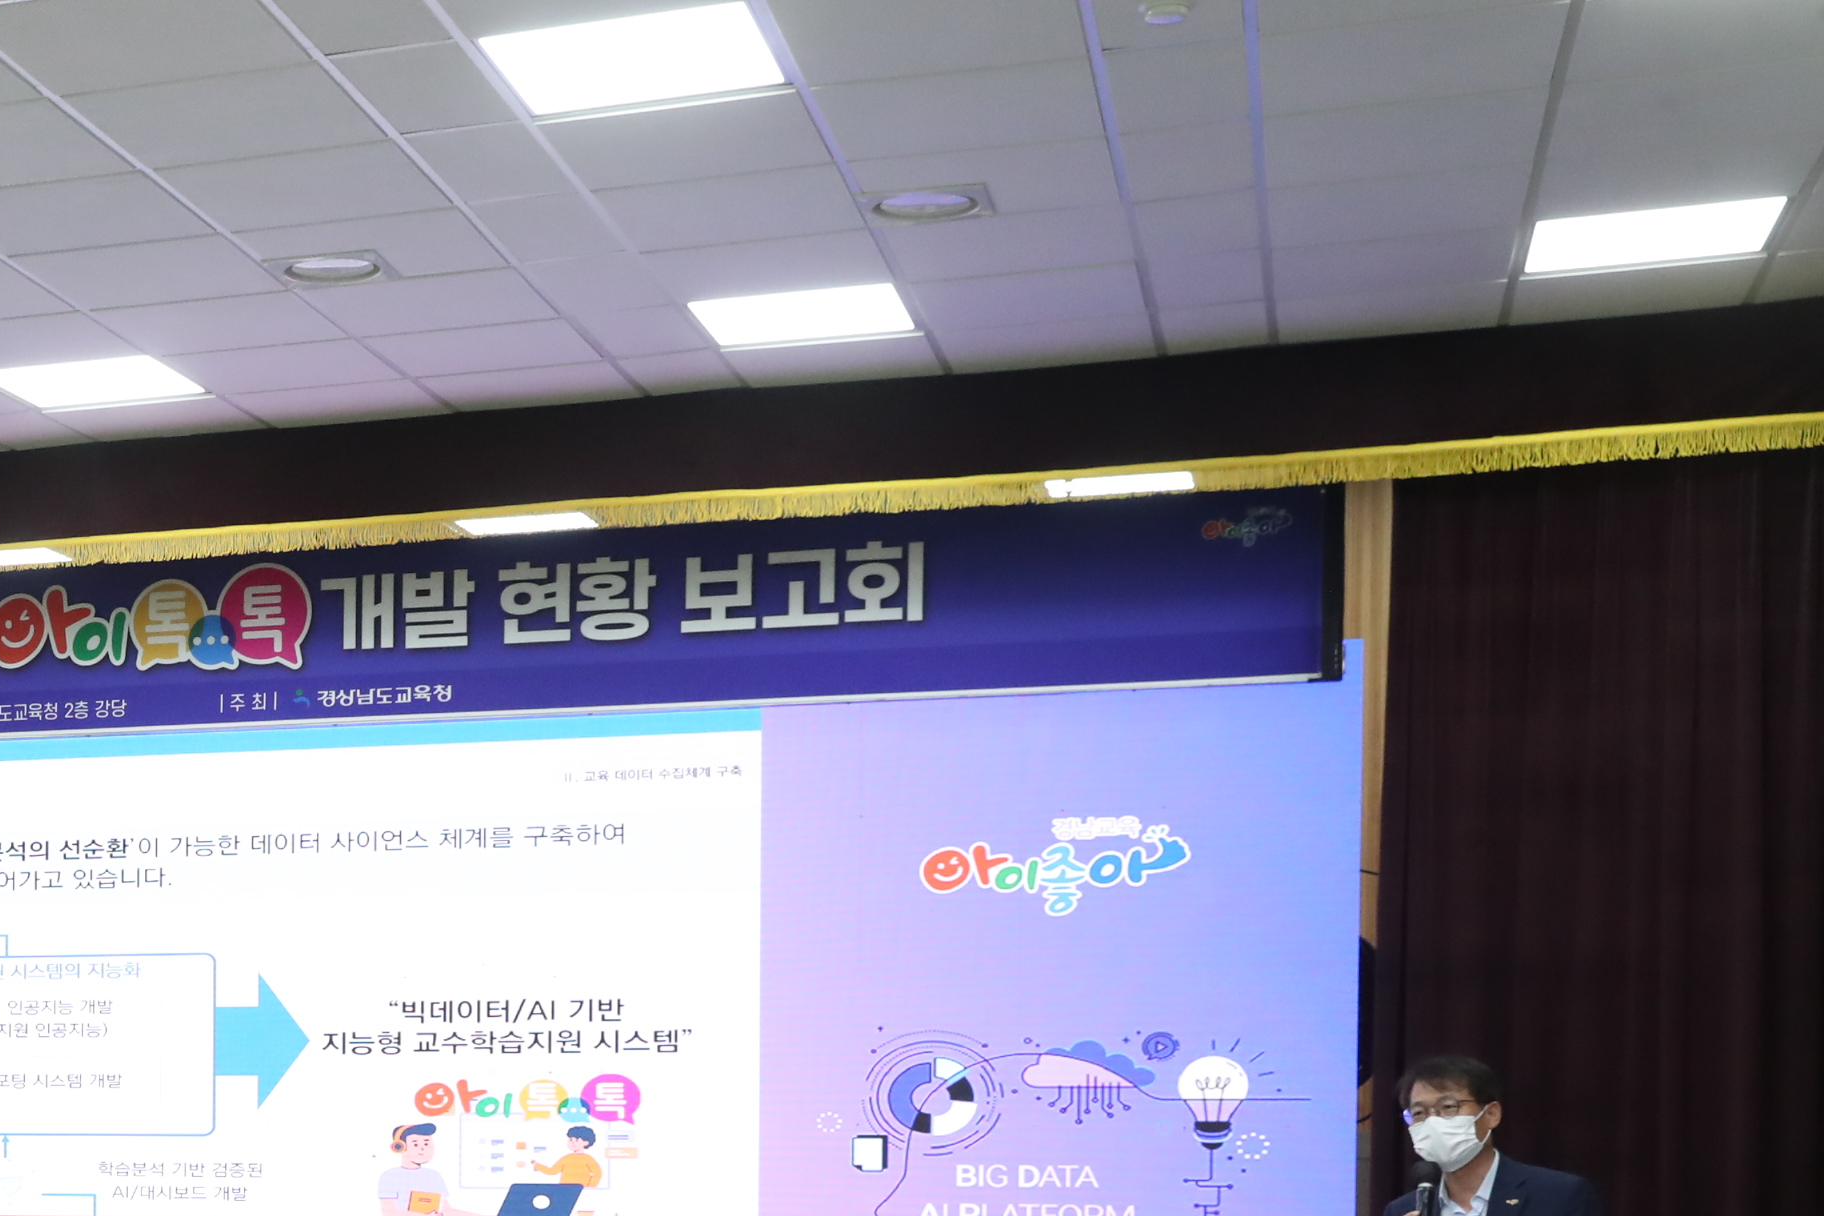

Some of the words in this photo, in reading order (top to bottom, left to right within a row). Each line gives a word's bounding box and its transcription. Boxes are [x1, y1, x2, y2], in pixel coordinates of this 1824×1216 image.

[319, 568, 475, 650] 개발
[497, 556, 656, 645] 현황
[679, 541, 924, 635] 보고회
[317, 684, 453, 707] 경상남도교육청
[64, 701, 89, 720] 2층
[94, 699, 127, 718] 강당
[615, 768, 653, 780] 데이터
[170, 835, 241, 857] 가능한
[251, 832, 320, 855] 데이터
[330, 829, 429, 852] 사이언스
[439, 826, 514, 850] 체계를
[524, 823, 626, 847] 구축하여
[73, 867, 172, 890] 있습니다.
[10, 963, 81, 981] 시스템의
[88, 962, 142, 979] 지능화
[7, 1000, 74, 1016] 인공지능
[80, 999, 113, 1015] 개발
[569, 998, 625, 1023] 기반
[322, 1030, 403, 1056] 지능형
[413, 1029, 582, 1055] 교수학습지원
[32, 1073, 82, 1089] 시스템
[89, 1073, 122, 1089] 개발
[414, 1073, 641, 1124] 아이톡톡
[98, 1160, 165, 1178] 학습분석
[172, 1161, 206, 1178] 기반
[213, 1161, 263, 1179] 검증된
[955, 1164, 1009, 1188] BIG
[1018, 1164, 1099, 1188] DATA
[112, 1184, 207, 1202] AI/대시보드
[213, 1184, 248, 1202] 개발
